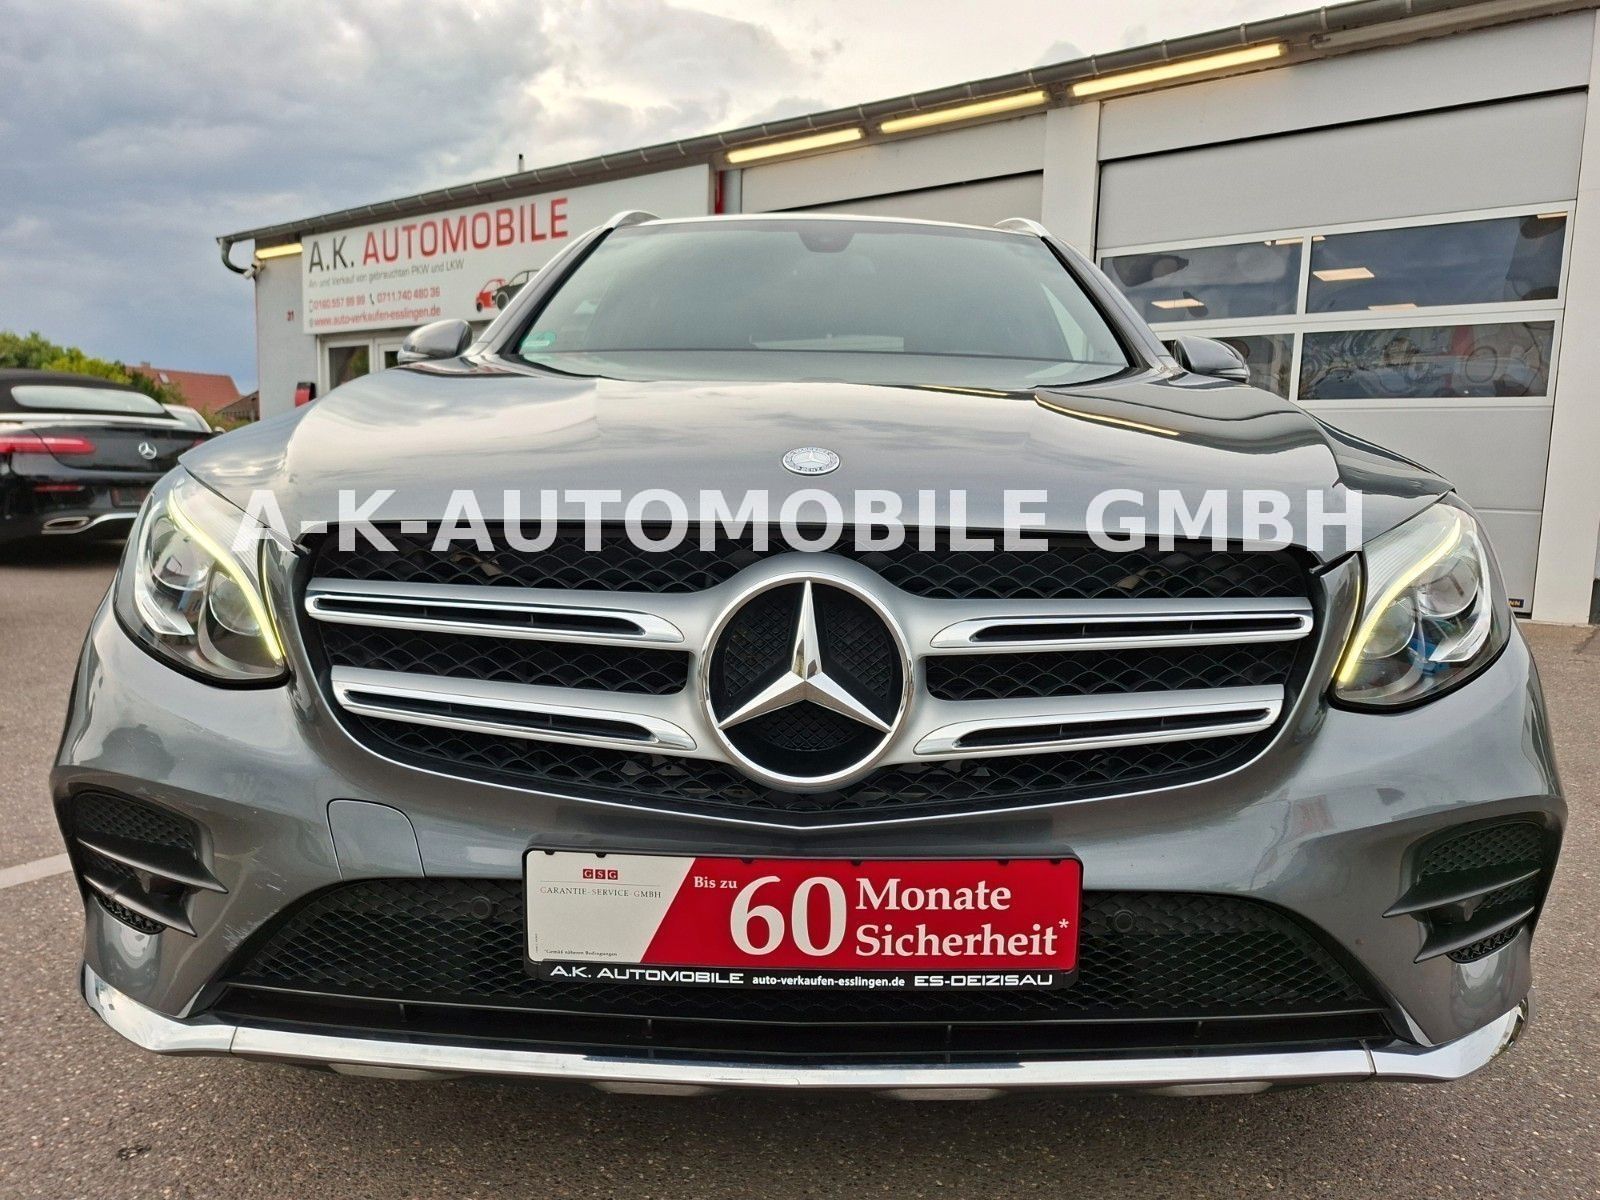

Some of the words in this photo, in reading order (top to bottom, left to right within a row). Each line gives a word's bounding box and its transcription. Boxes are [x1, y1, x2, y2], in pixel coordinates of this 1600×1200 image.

[308, 235, 355, 273] A.K.
[363, 197, 569, 266] AUTOMOBILE
[369, 266, 410, 284] gebrauchten
[411, 263, 430, 275] PKW
[431, 261, 445, 273] und
[446, 258, 465, 271] LKW
[377, 290, 396, 304] 0711
[398, 288, 412, 301] 740
[413, 287, 429, 299] 480
[583, 869, 618, 880] GSG
[693, 876, 716, 889] Bis
[719, 879, 738, 890] zu
[855, 877, 1012, 911] Monate
[730, 875, 848, 957] 60
[550, 965, 592, 978] A.K.
[597, 967, 744, 984] AUTOMOBILE
[752, 974, 905, 989] auto-verkaufen-esslingen.de
[914, 974, 1053, 987] ES-DEIZISAU
